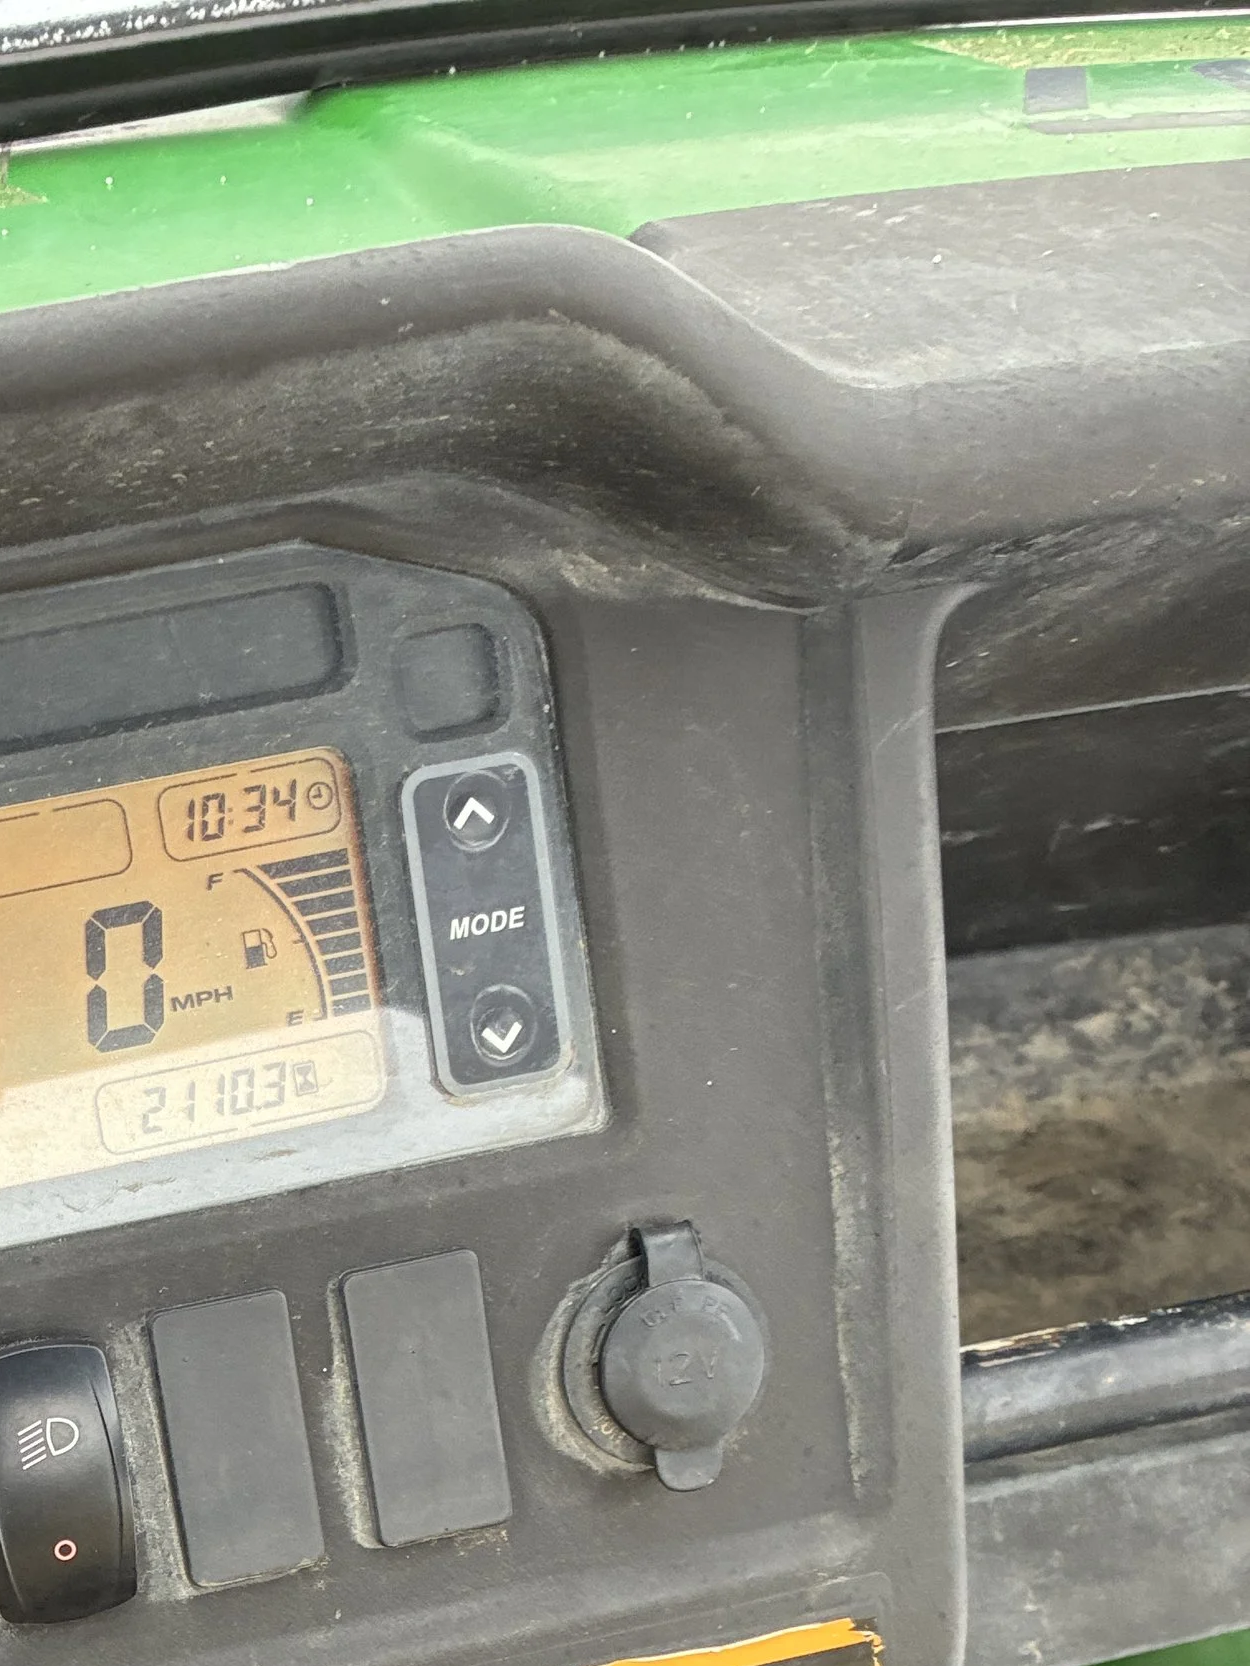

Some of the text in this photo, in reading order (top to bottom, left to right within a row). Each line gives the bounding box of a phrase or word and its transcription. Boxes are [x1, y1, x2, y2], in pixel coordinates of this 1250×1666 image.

[185, 778, 298, 843] 10:34
[206, 872, 224, 892] F
[449, 905, 526, 941] MODE
[170, 986, 234, 1013] MPH
[286, 1009, 305, 1027] E
